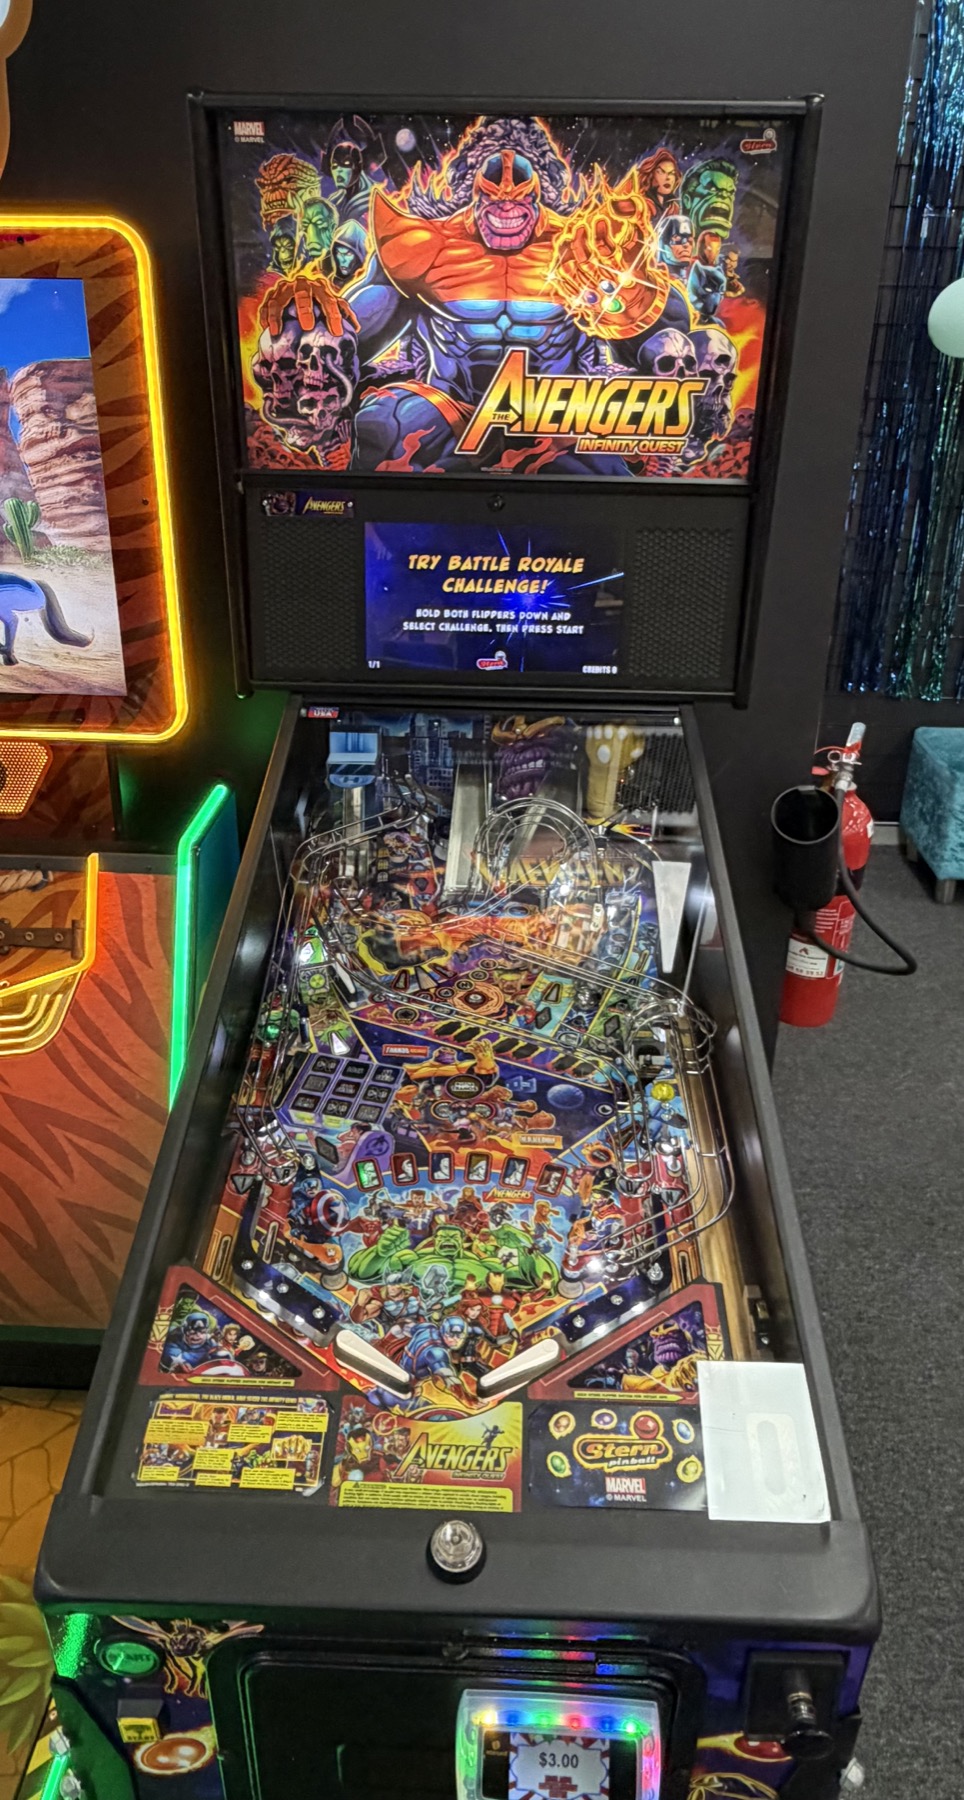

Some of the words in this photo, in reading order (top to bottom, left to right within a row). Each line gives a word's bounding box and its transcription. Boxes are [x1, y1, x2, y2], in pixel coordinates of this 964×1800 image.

[234, 121, 264, 136] MARVEL
[459, 350, 706, 452] AVENGERS
[491, 412, 511, 422] THE
[578, 438, 637, 452] INFINITY
[639, 440, 685, 453] QUEST
[302, 496, 346, 514] AVENGERS
[408, 554, 441, 570] TRY
[448, 555, 511, 572] BATTLE
[517, 557, 585, 574] ROYALE
[442, 577, 549, 594] CHALLENGE!
[415, 608, 441, 618] HOLD
[443, 609, 469, 619] BOTH
[471, 610, 516, 620] FLIPPERS
[519, 611, 549, 621] DOWN
[551, 612, 571, 621] AND
[402, 621, 436, 631] SELECT
[495, 623, 519, 633] THEN
[522, 624, 553, 634] PRESS
[556, 625, 584, 635] START
[368, 660, 381, 669] 1/1
[582, 665, 610, 674] CREDITS
[313, 709, 334, 718] USA
[484, 1186, 531, 1201] AVENGERS
[394, 1432, 512, 1477] AVENGERS
[586, 1443, 661, 1459] Stern
[608, 1456, 656, 1467] pinball
[606, 1477, 646, 1494] MARVEL
[614, 1494, 647, 1502] MARVEL
[539, 1752, 579, 1768] $3.00
